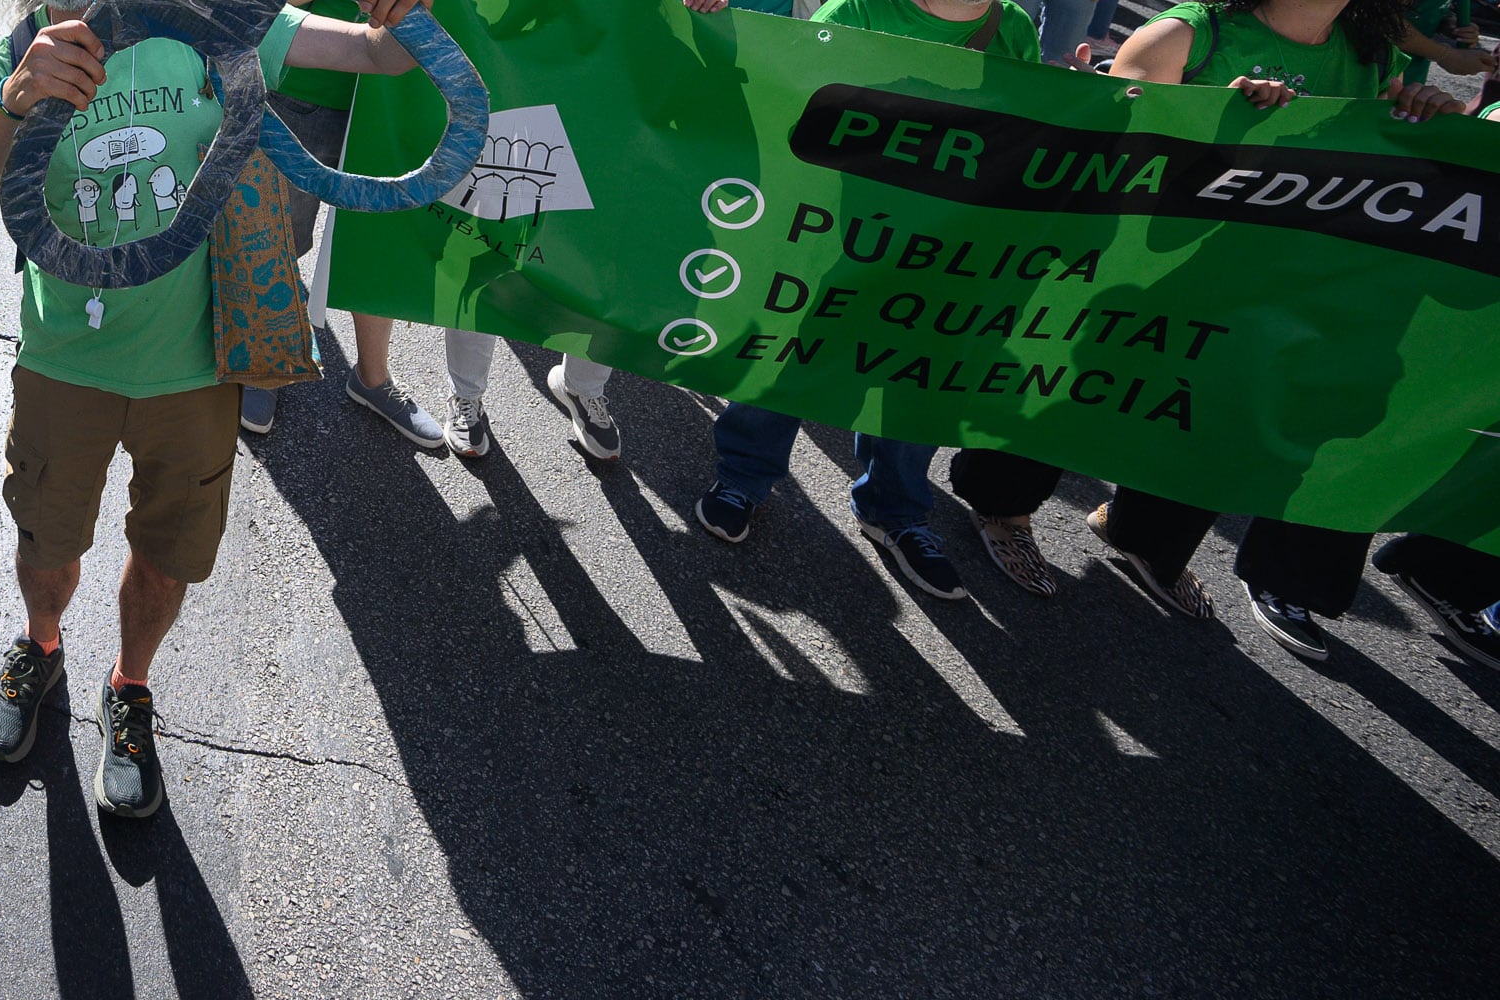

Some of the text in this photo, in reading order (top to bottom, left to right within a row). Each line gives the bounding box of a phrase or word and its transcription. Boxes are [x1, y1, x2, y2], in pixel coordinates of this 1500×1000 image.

[827, 108, 1483, 242] PER UNA EDUCA
[426, 203, 546, 265] RIBALTA
[786, 202, 1101, 283] PÚBLICA
[763, 272, 1231, 362] DE QUALITAT
[735, 334, 1194, 433] EN VALENCIÀ
